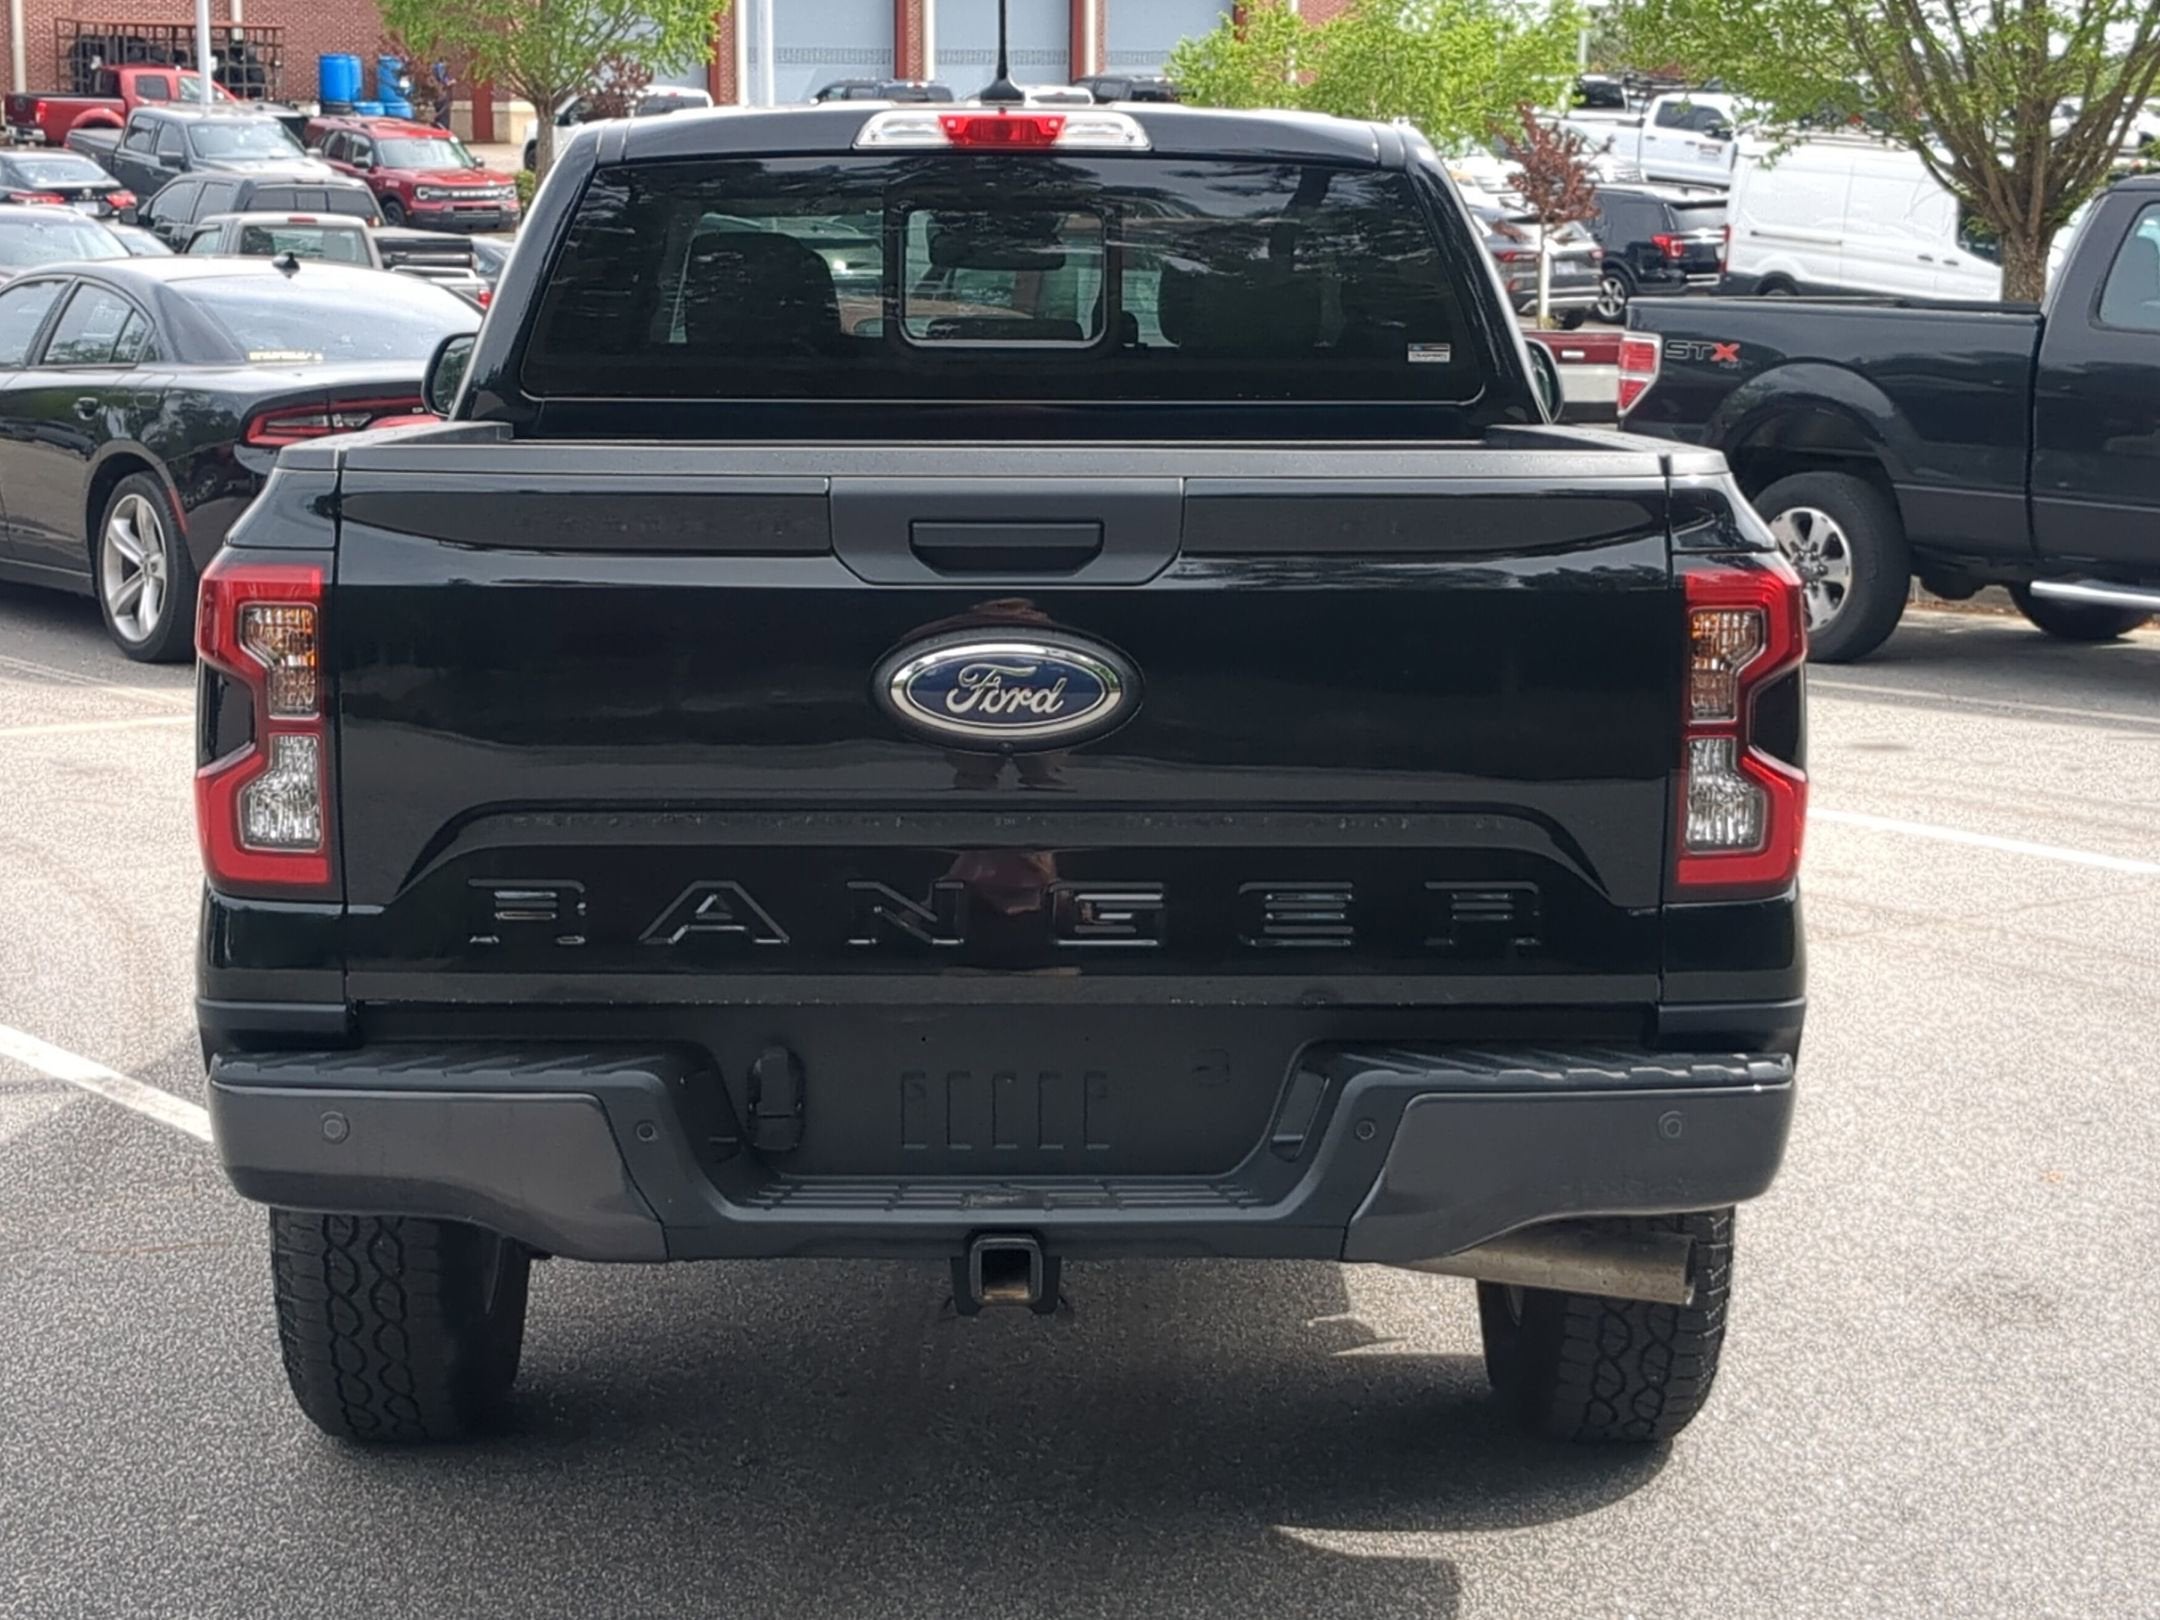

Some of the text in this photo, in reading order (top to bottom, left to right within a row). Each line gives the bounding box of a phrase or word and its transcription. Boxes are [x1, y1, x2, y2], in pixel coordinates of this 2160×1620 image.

[1664, 340, 1740, 362] STX
[946, 663, 1068, 714] Ford
[469, 879, 1541, 946] RANGER
